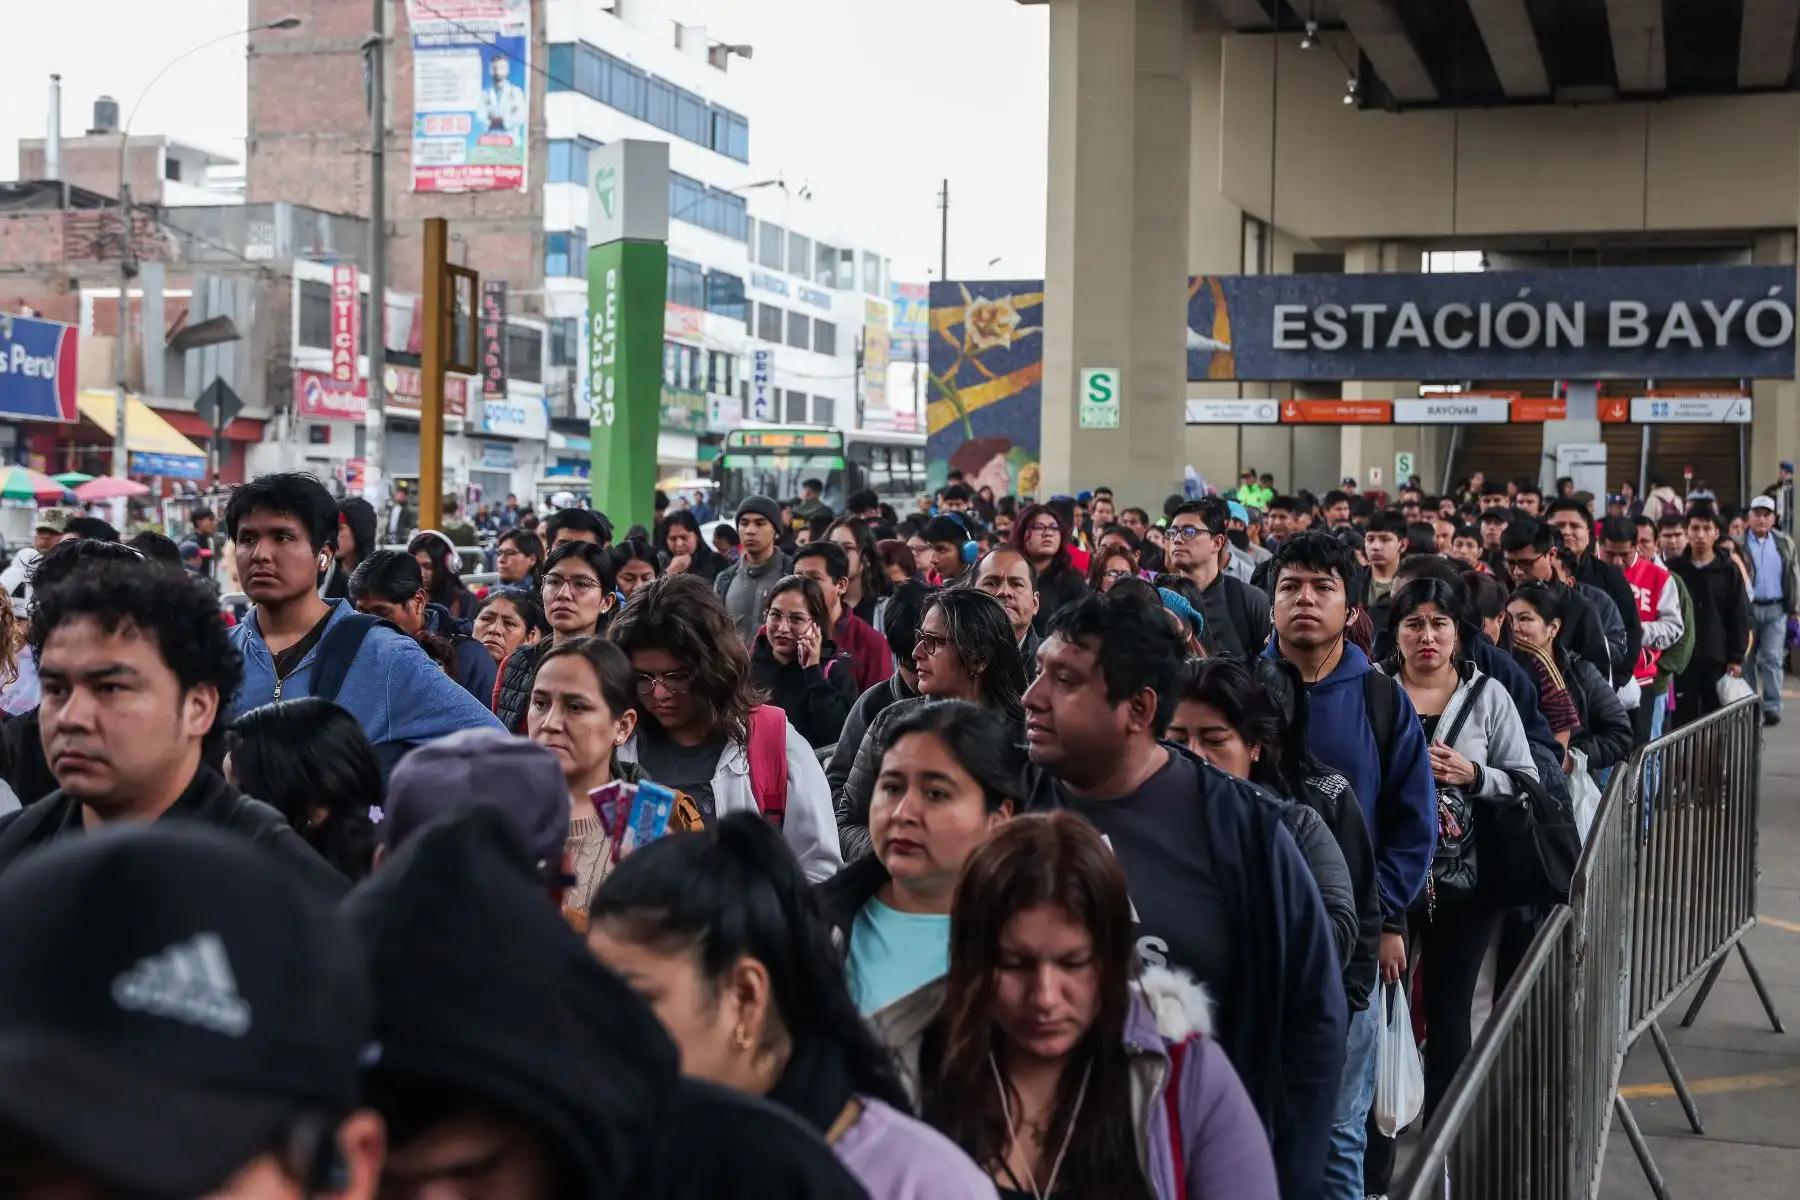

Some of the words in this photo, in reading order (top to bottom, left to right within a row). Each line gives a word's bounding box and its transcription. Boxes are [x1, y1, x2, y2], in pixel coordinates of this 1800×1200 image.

[334, 268, 351, 381] BOTICAS
[602, 268, 615, 364] Lima
[1273, 287, 1585, 349] ESTACIÓN
[590, 312, 603, 428] Metro
[602, 376, 615, 426] de
[755, 350, 767, 418] DENTAL
[1089, 374, 1112, 403] S
